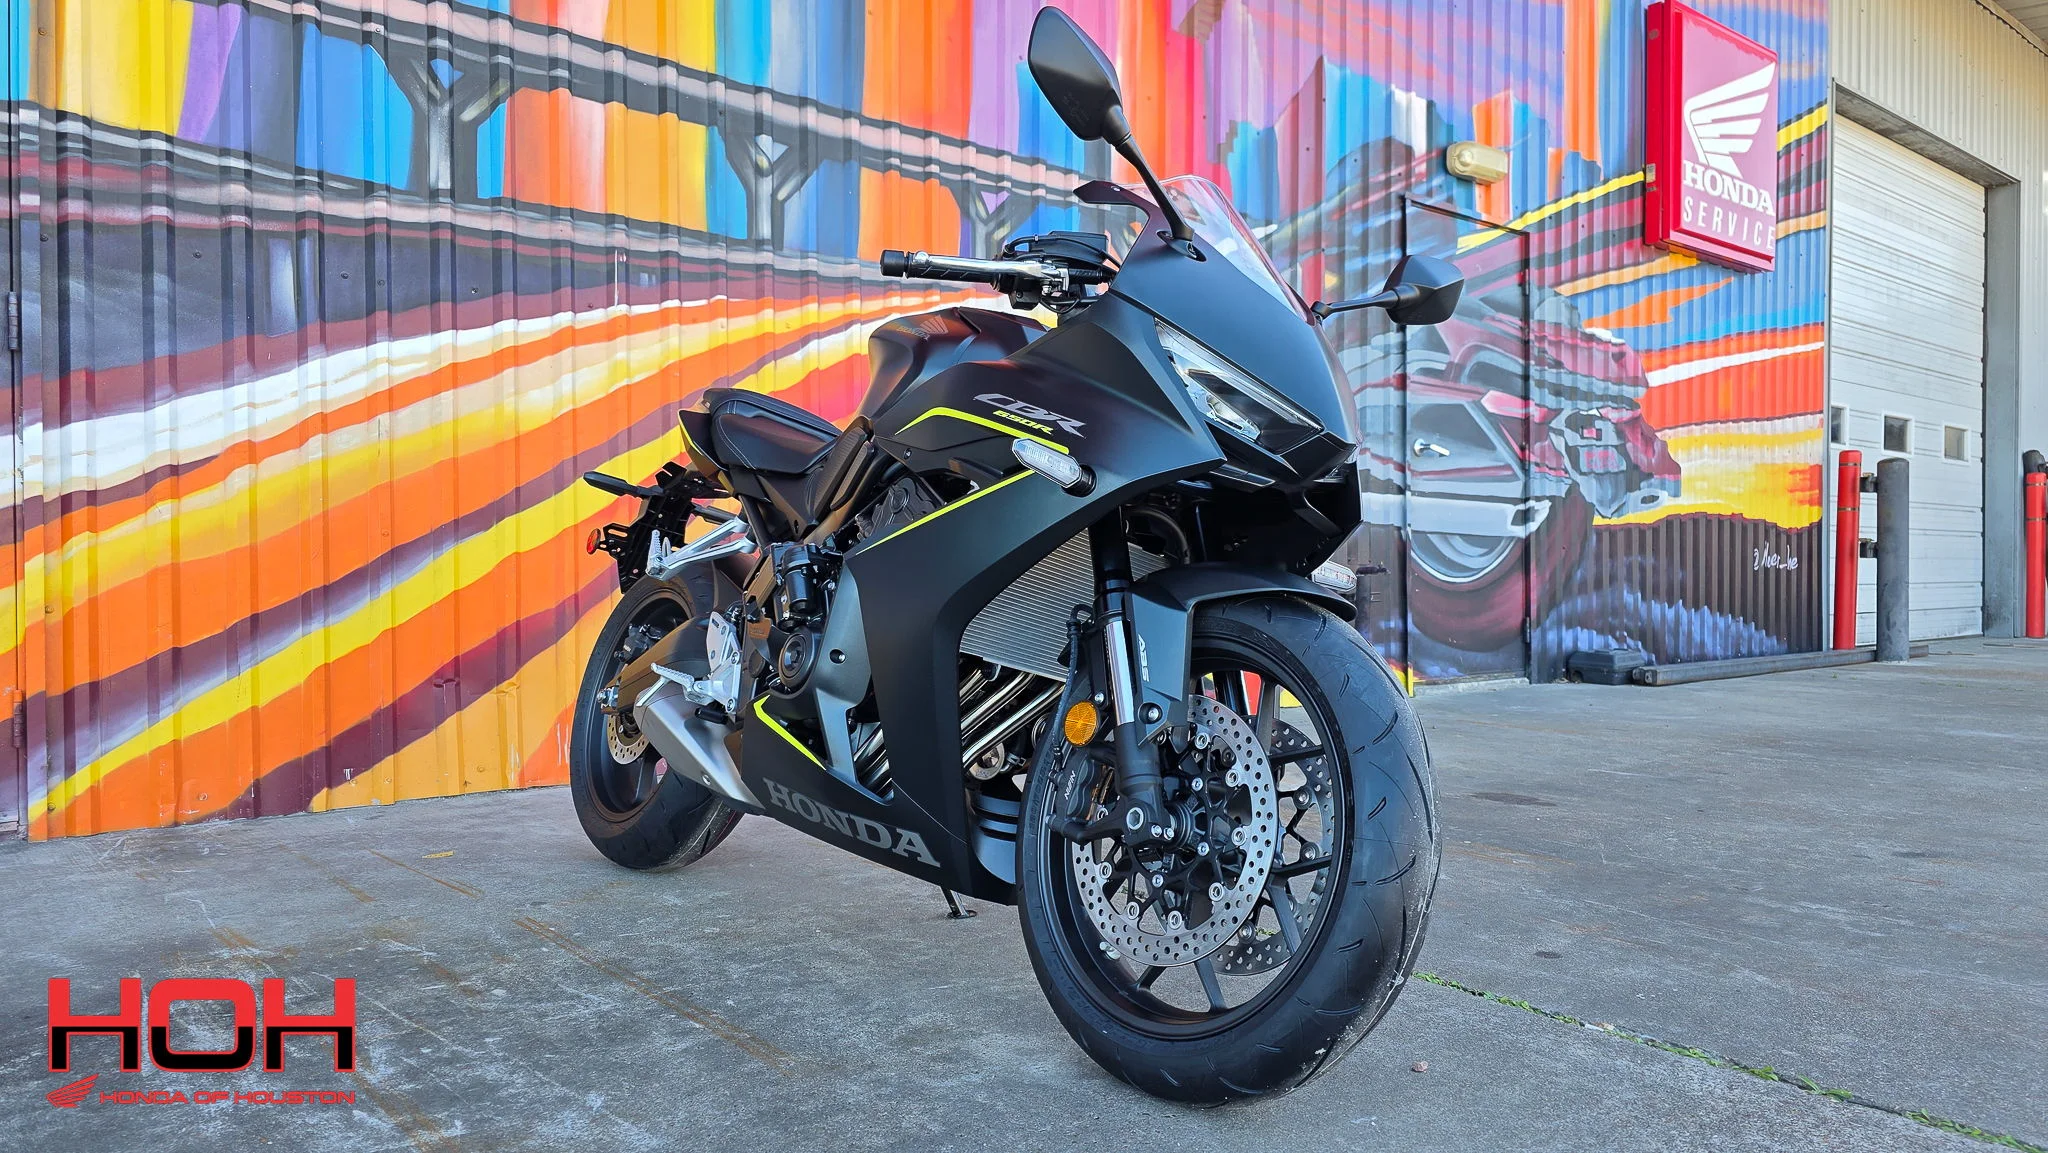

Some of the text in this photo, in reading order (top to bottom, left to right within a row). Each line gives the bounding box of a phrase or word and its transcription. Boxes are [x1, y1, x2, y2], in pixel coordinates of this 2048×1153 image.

[1683, 159, 1775, 216] HONDA
[1683, 196, 1775, 250] SERVICE
[973, 393, 1086, 439] CBR
[993, 409, 1054, 435] 650R
[1138, 633, 1150, 682] ABS
[762, 777, 941, 868] HONDA
